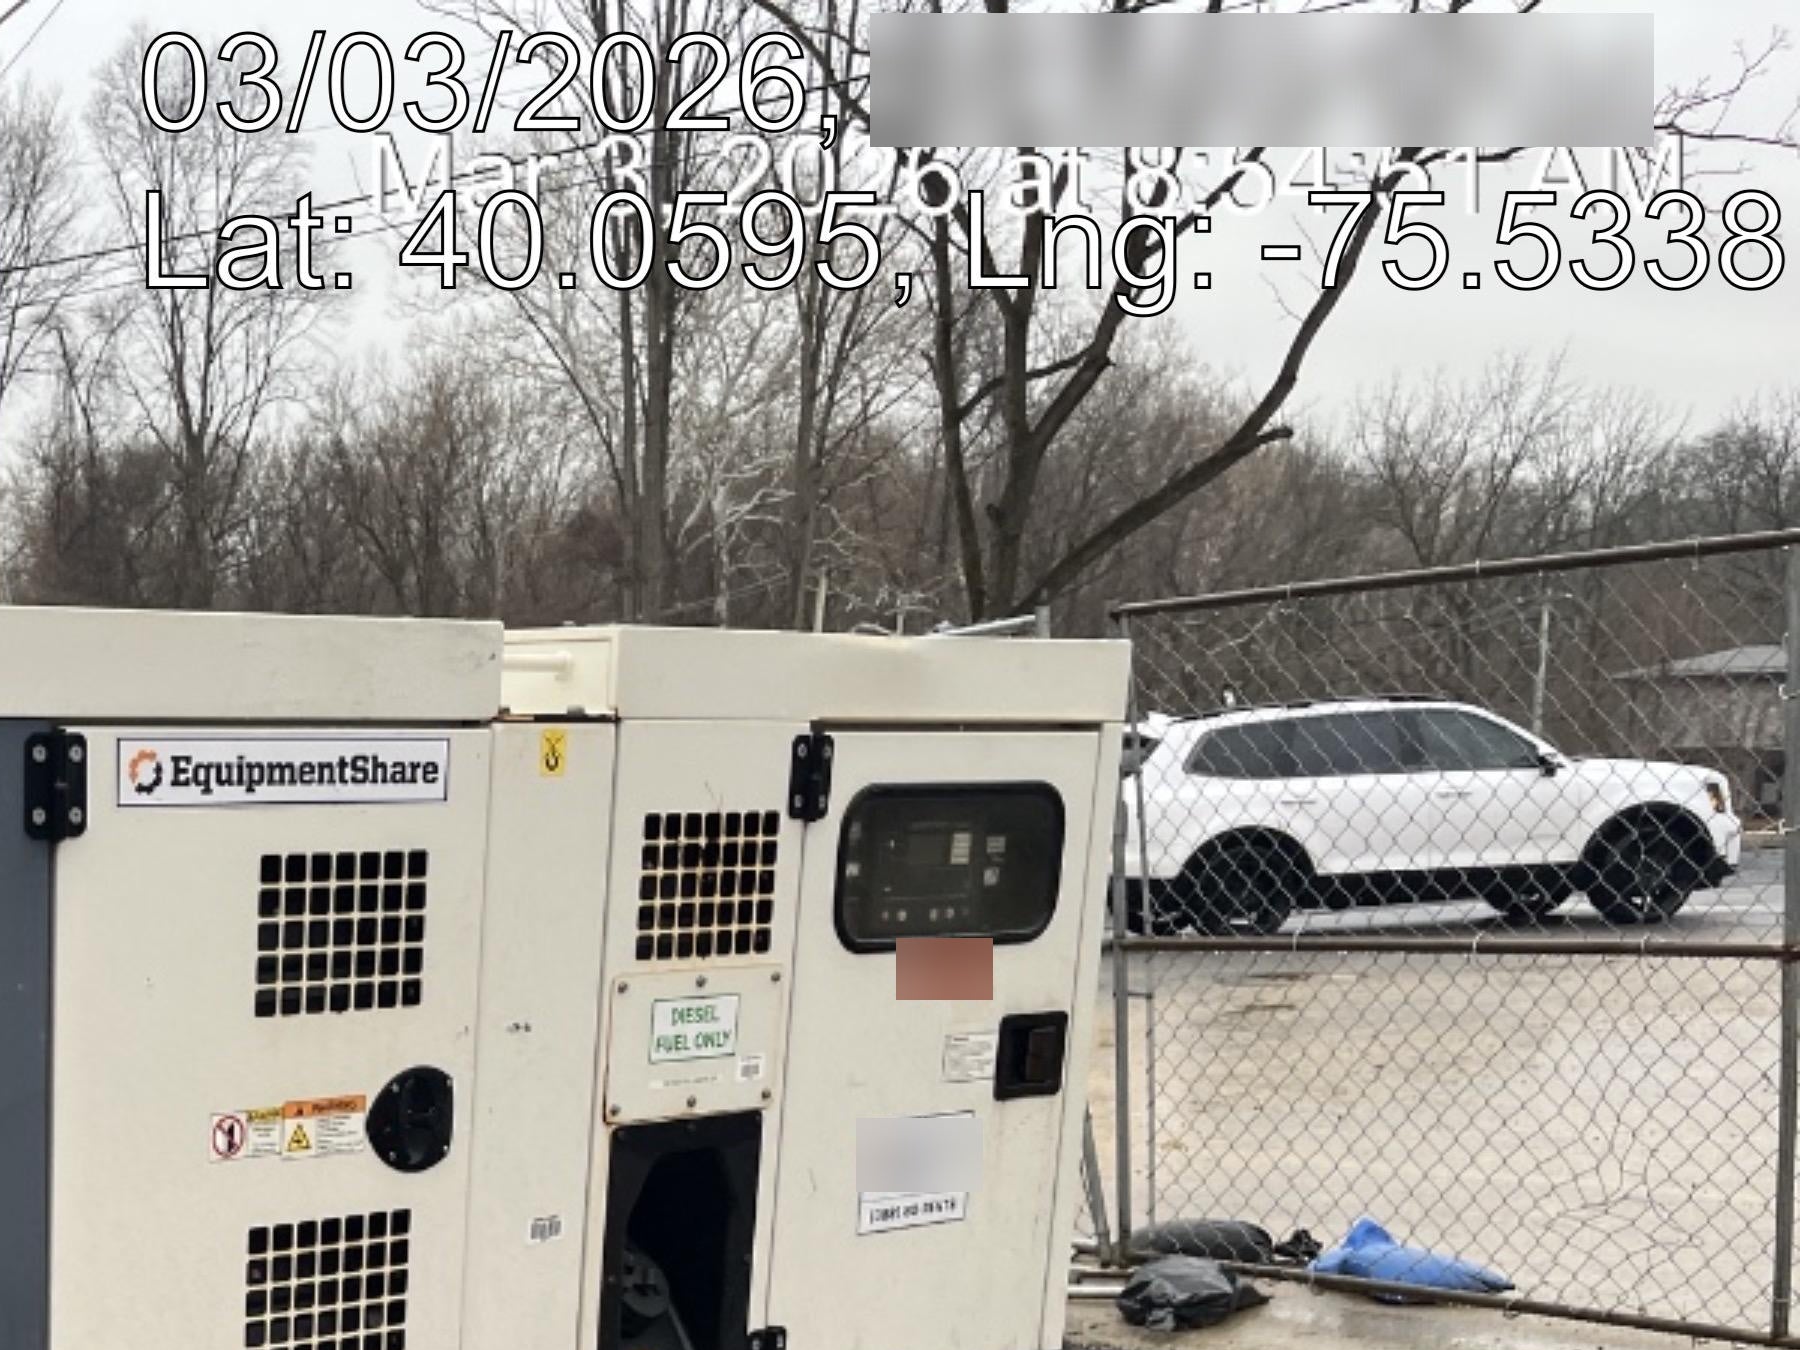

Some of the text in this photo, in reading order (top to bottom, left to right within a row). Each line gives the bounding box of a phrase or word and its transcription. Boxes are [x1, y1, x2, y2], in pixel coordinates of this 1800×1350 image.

[169, 754, 440, 795] EquipmentShare
[670, 1004, 721, 1026] DIESEL
[655, 1028, 733, 1053] FUEL ONLY
